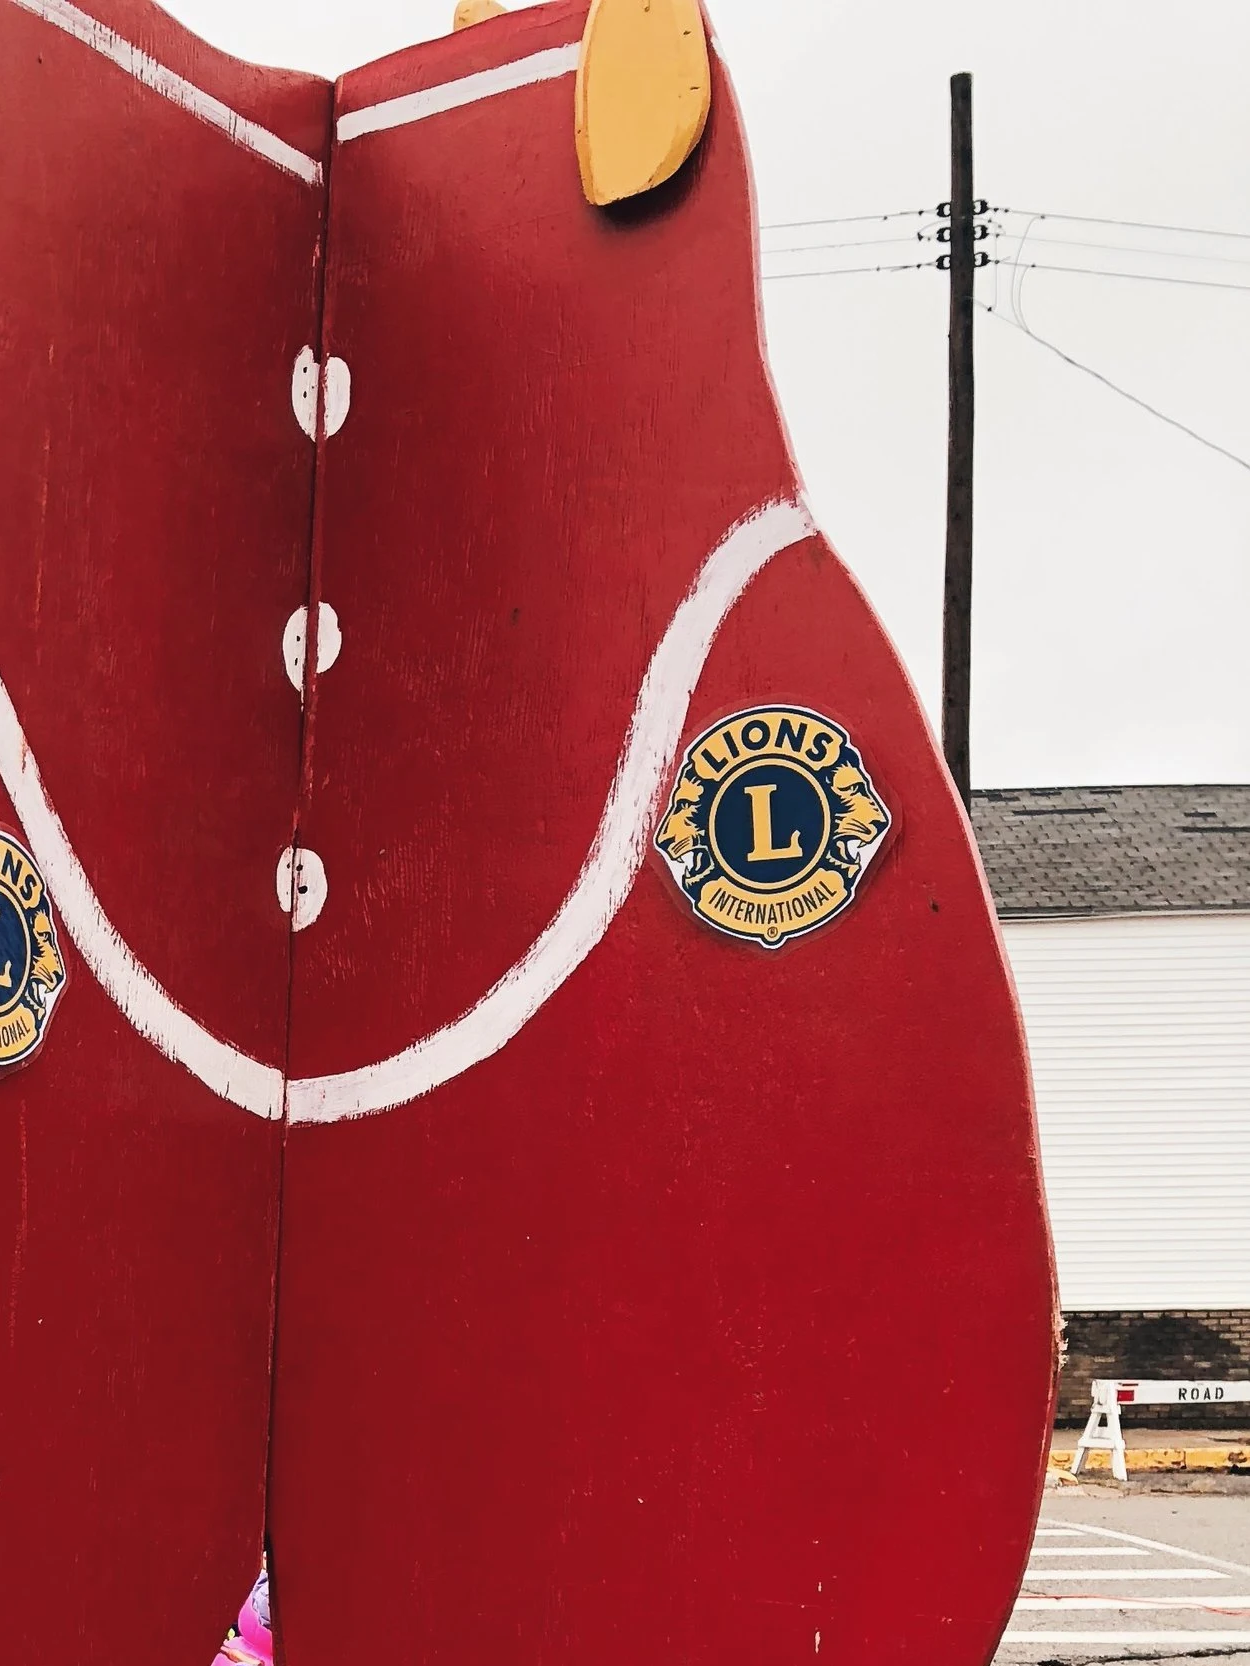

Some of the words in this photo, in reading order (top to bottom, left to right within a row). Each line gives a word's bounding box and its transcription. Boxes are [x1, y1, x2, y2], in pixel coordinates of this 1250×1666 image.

[700, 718, 834, 774] LIONS
[744, 783, 804, 862] L
[708, 880, 838, 925] INTERNATIONAL
[1178, 1387, 1225, 1401] ROAD
